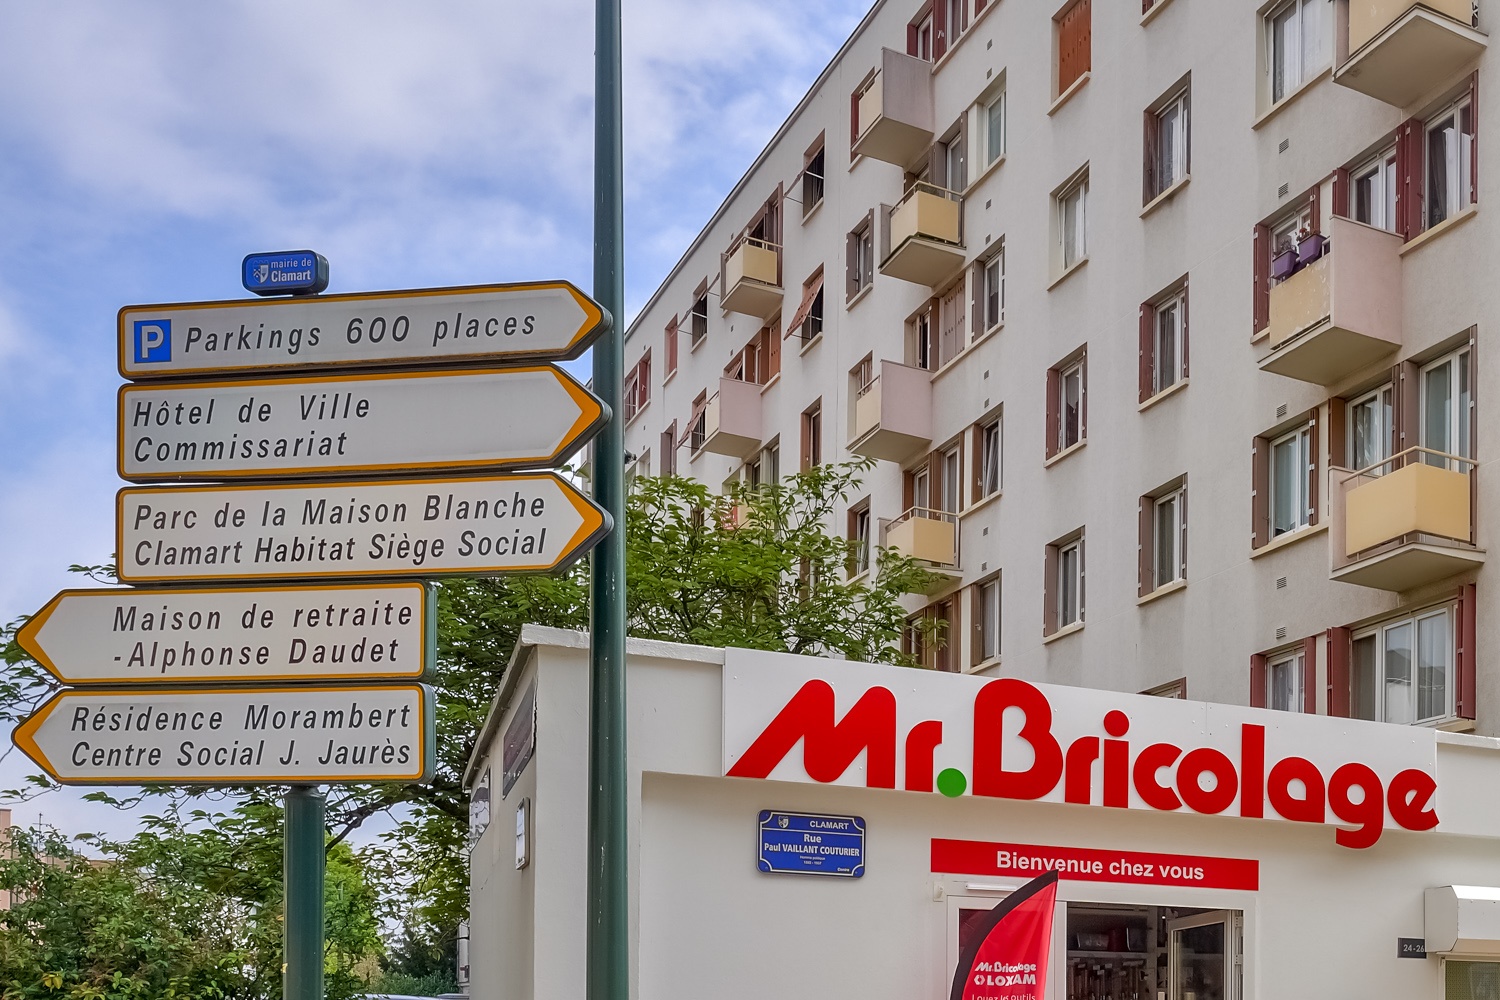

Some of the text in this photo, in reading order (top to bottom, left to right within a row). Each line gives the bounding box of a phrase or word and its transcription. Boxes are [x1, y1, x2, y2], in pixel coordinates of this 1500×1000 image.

[271, 258, 312, 269] mairie de
[271, 270, 311, 282] Clamart
[184, 322, 321, 355] Parkings
[345, 315, 411, 345] 600
[431, 312, 536, 346] places
[132, 392, 370, 427] Hôtel de Ville
[133, 431, 348, 463] Commissariat
[133, 491, 545, 531] Parc de la Maison Blanche
[134, 527, 547, 566] Clamart Habitat Siège Social
[112, 600, 413, 632] Maison de retraite
[288, 637, 399, 665] Daudet
[71, 702, 411, 732] Résidence Morambert
[71, 736, 410, 767] Centre Social J. Jaurès
[803, 833, 822, 843] Rue
[809, 820, 849, 830] CLAMART
[764, 842, 860, 857] Paul VAILLANT COUTURIER
[996, 850, 1205, 881] Bienvenue chez vous
[1403, 943, 1425, 953] 24-26
[986, 974, 1036, 986] LOXAM
